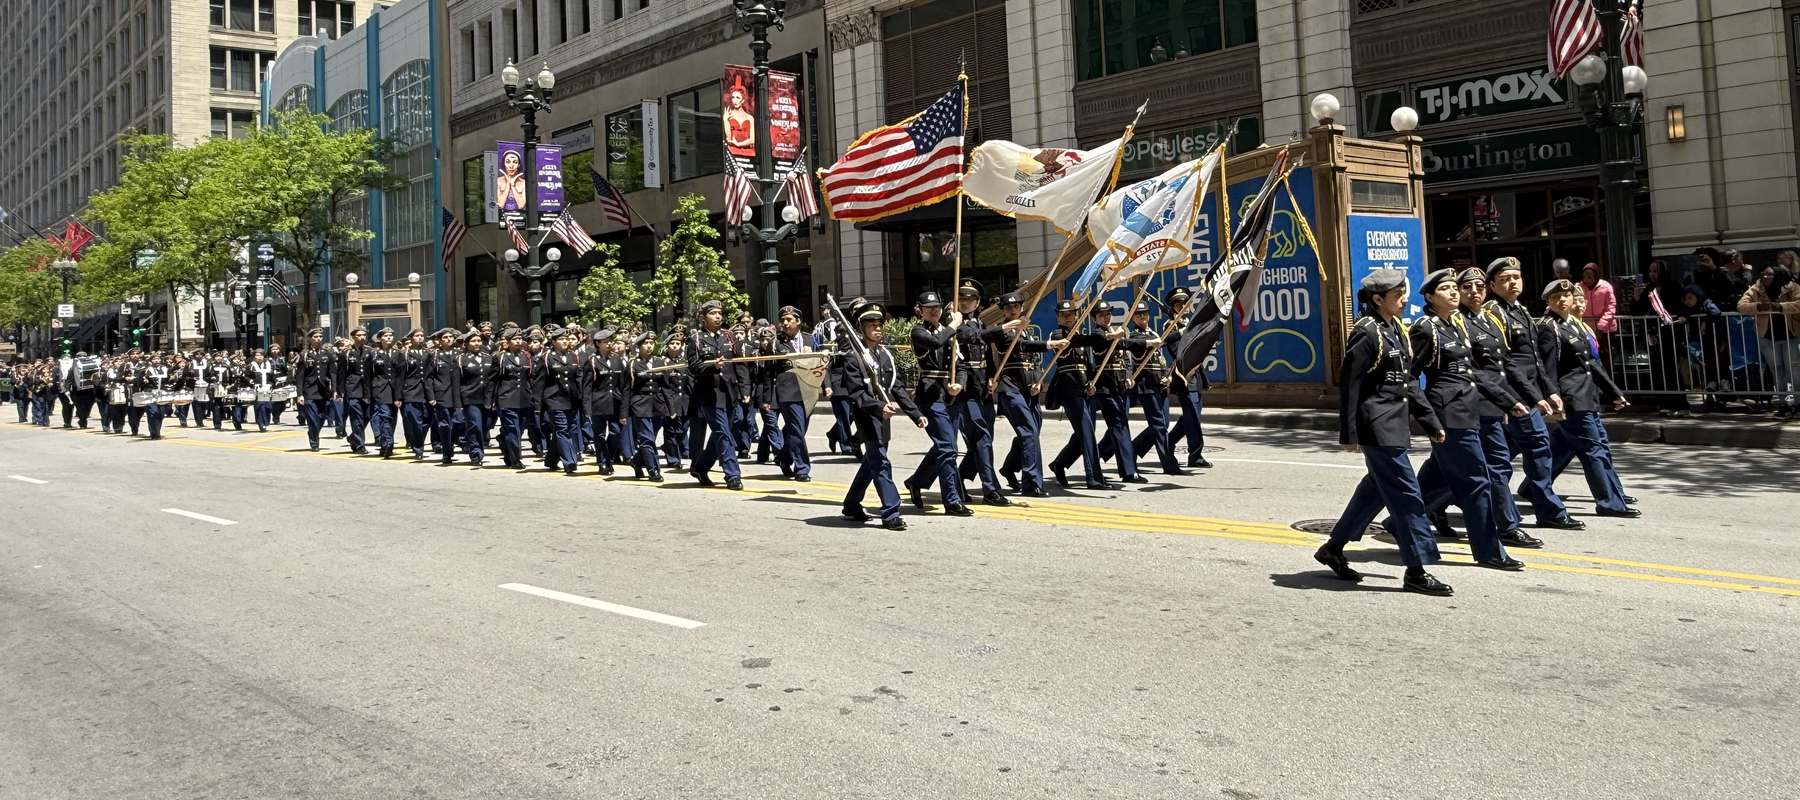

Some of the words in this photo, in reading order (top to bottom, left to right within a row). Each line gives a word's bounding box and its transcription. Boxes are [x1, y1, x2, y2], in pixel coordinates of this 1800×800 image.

[647, 117, 655, 161] CommunityTax
[1136, 132, 1217, 161] Payless
[1422, 141, 1572, 173] Burlington
[1260, 266, 1308, 286] GHBOR
